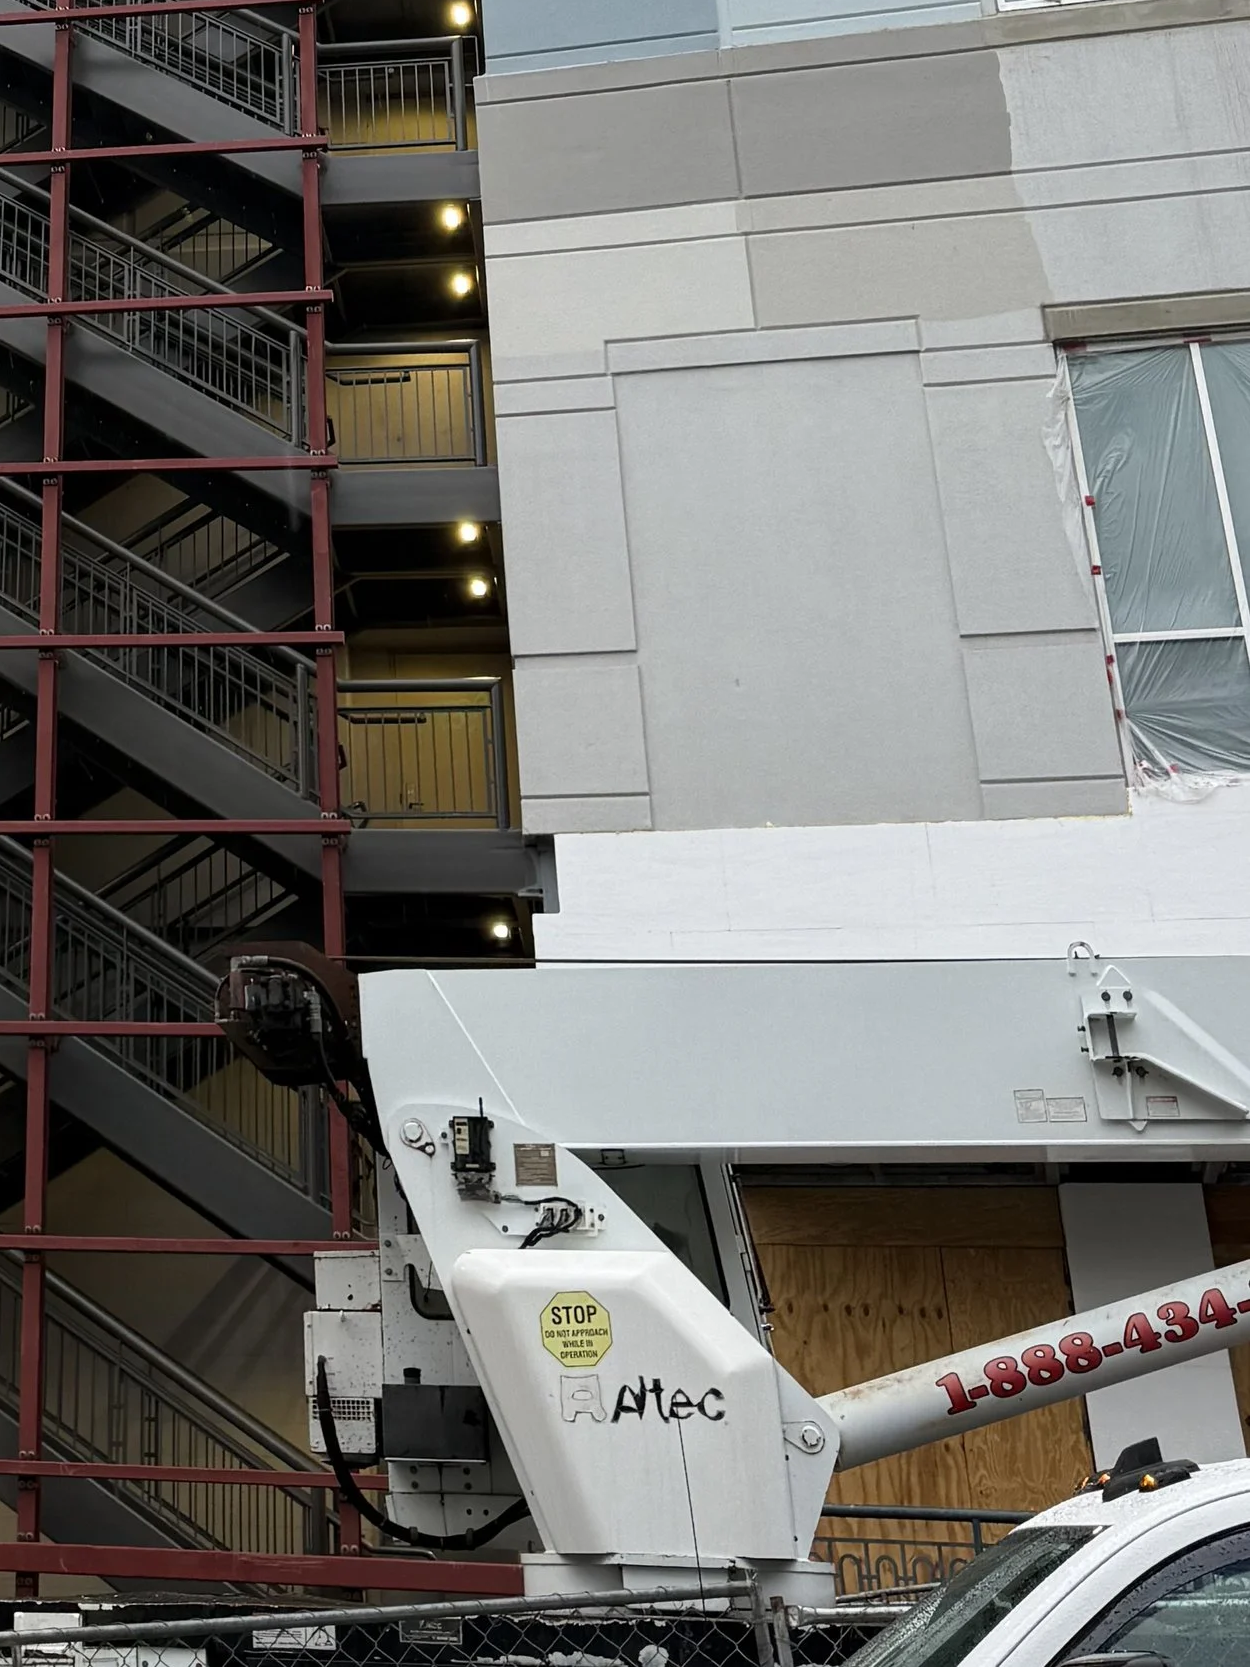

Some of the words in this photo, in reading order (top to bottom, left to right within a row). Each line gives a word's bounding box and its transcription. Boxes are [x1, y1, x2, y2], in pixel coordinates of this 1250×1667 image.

[551, 1304, 597, 1325] STOP
[544, 1330, 555, 1339] DO
[557, 1329, 570, 1338] NOT
[572, 1328, 609, 1337] APPROACH
[562, 1339, 585, 1348] WHILE
[935, 1279, 1250, 1416] 1-888-434-
[560, 1350, 598, 1359] OPERATION
[610, 1375, 726, 1424] Altec
